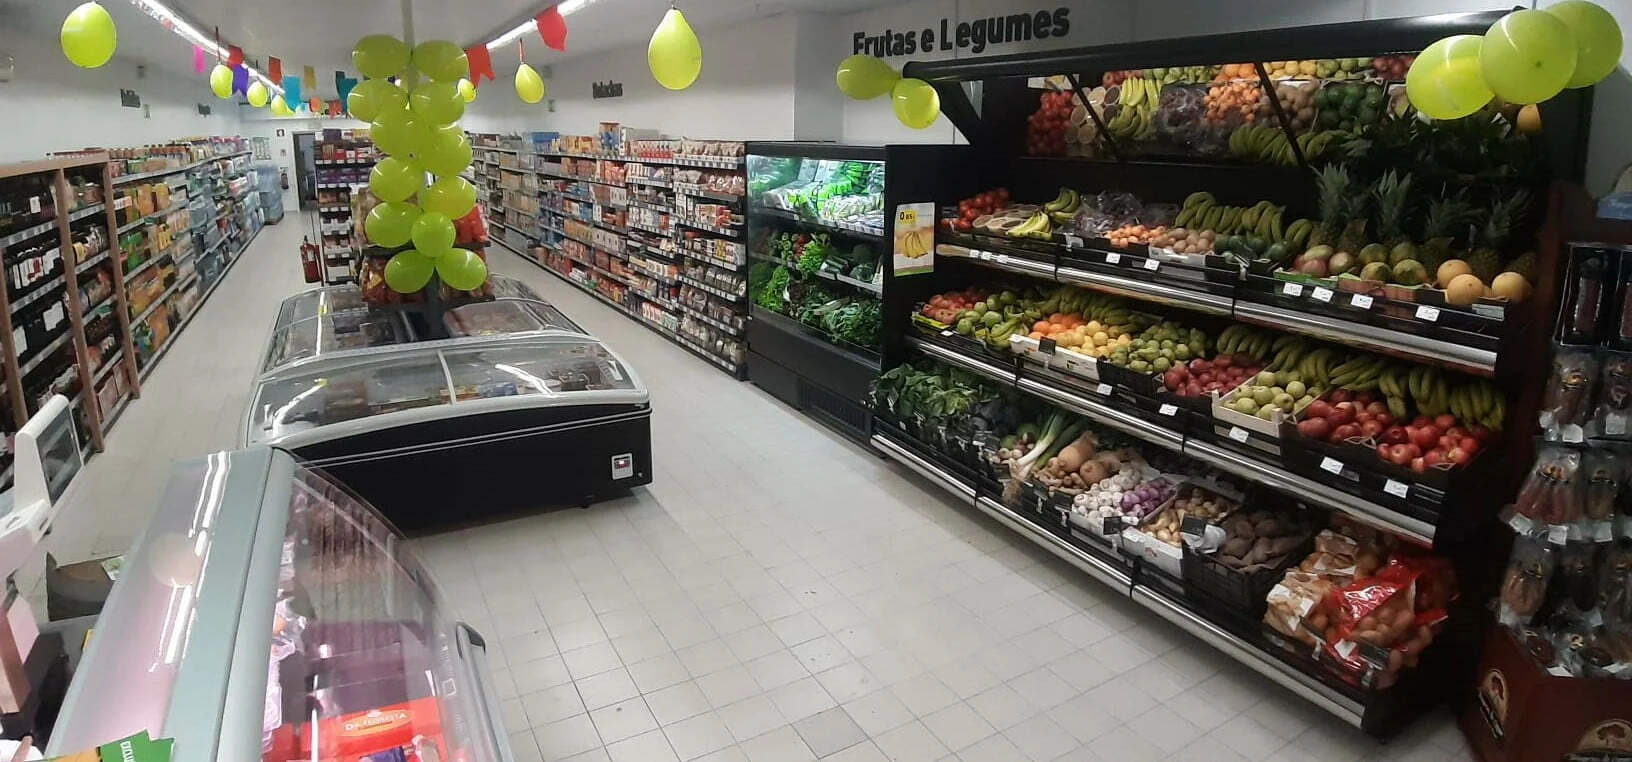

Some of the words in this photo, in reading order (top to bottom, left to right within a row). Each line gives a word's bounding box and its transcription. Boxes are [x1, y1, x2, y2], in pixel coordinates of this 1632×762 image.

[853, 29, 916, 57] Frutas
[920, 28, 935, 52] e
[939, 7, 1070, 54] Legumes
